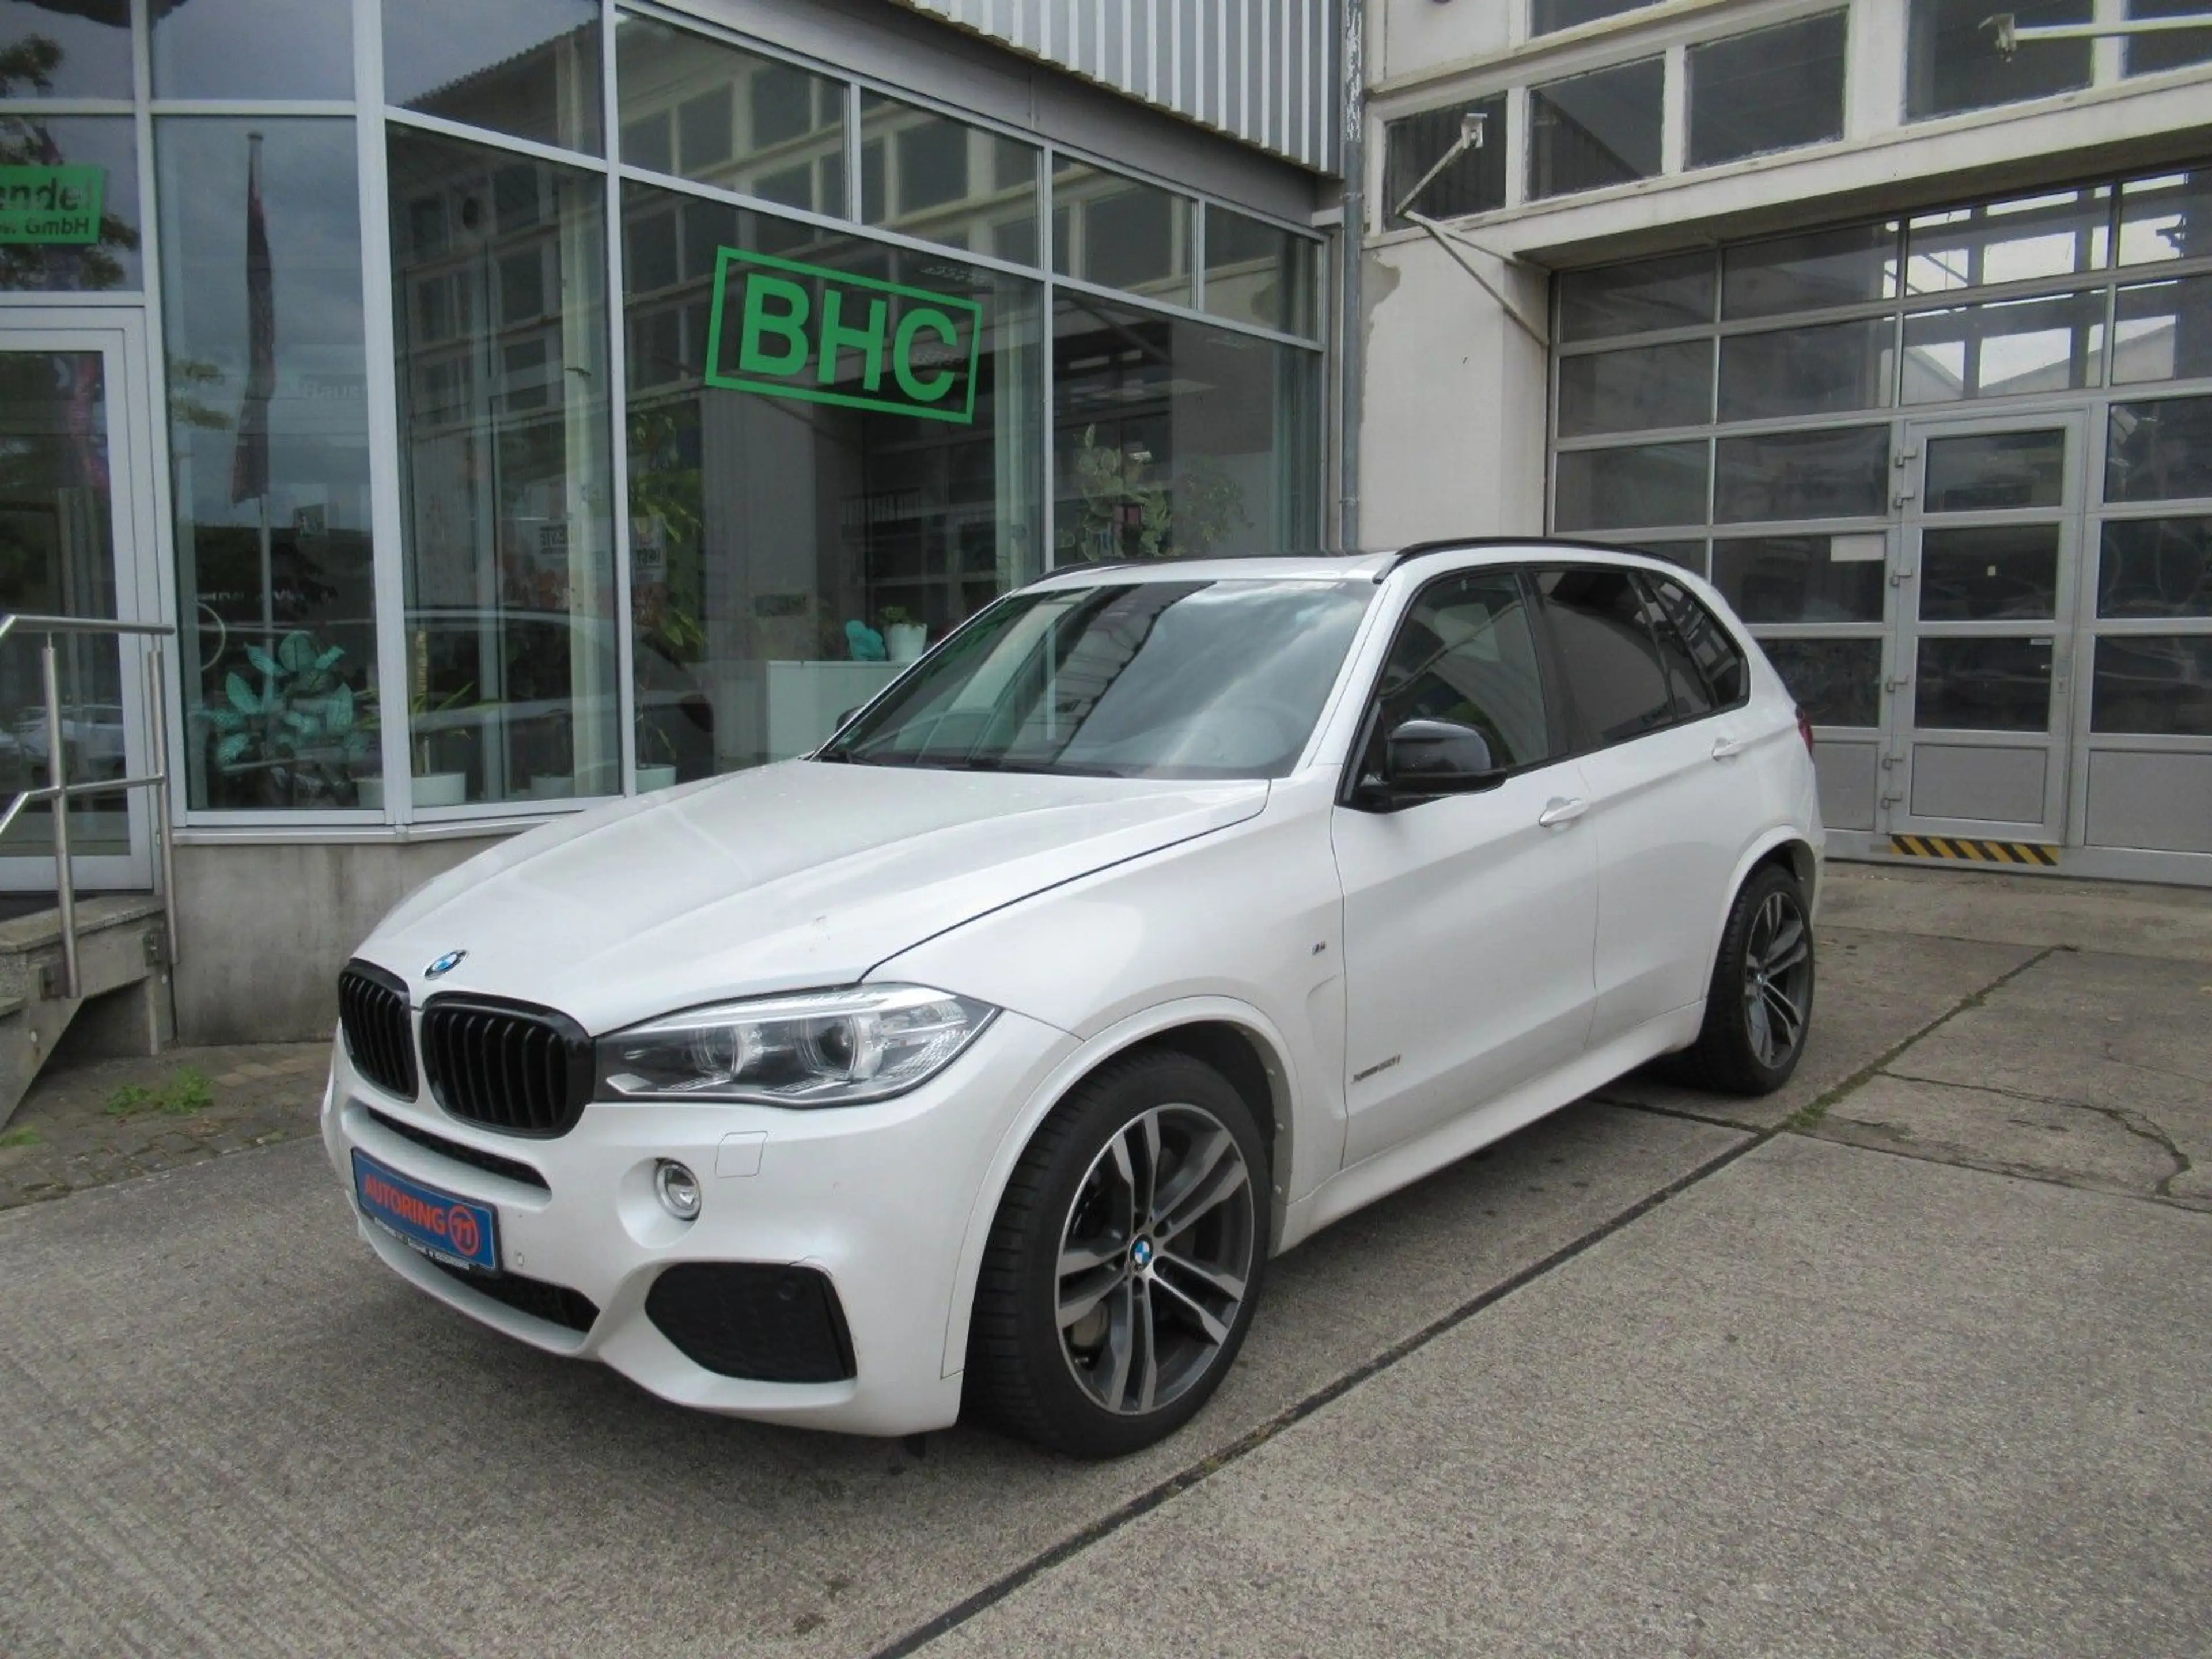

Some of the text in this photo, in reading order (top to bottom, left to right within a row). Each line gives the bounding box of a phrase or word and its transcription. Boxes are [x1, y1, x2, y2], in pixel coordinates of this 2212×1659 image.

[25, 217, 89, 235] GmbH
[739, 273, 957, 402] BHC
[365, 1175, 446, 1234] AUTORING
